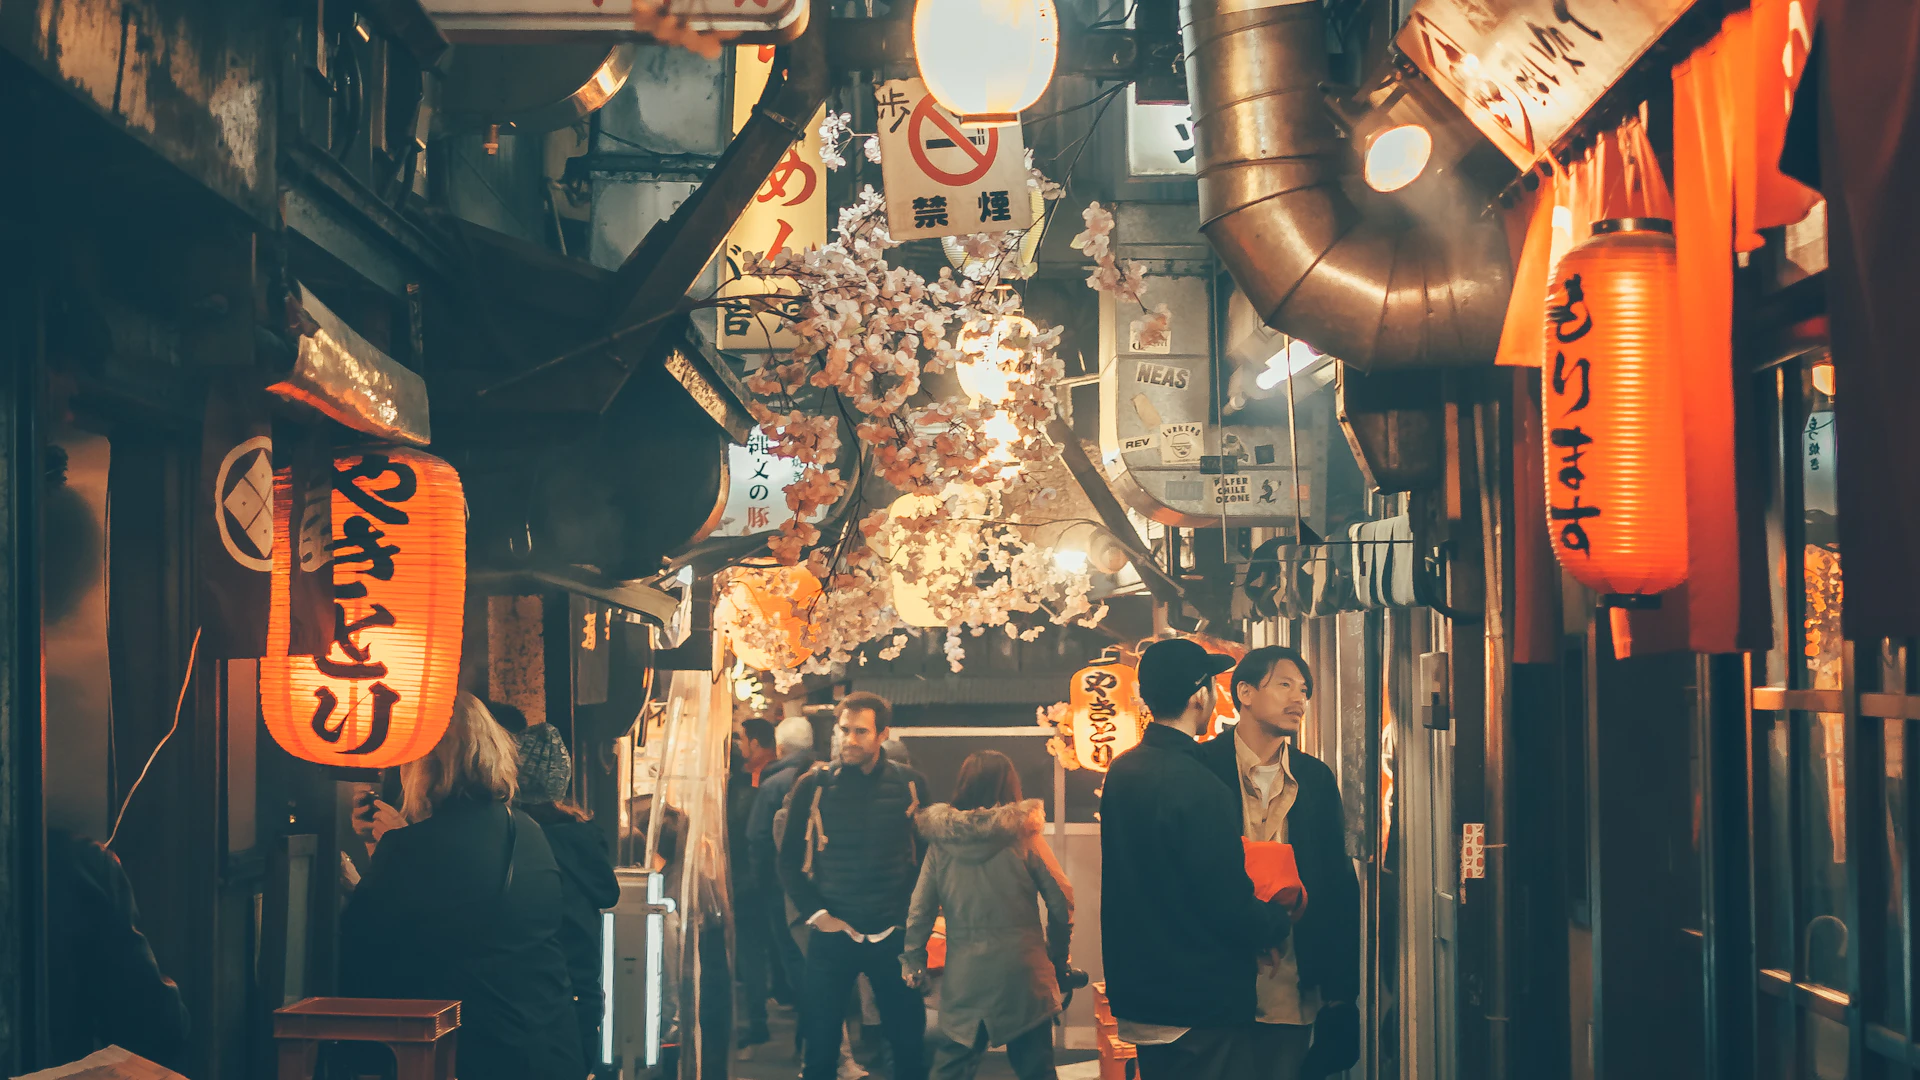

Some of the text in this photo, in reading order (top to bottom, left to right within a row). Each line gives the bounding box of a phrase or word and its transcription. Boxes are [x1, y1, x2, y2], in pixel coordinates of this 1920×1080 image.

[912, 190, 1012, 229] 禁煙
[1137, 363, 1188, 389] NEAS
[1125, 437, 1150, 449] REV
[1213, 477, 1248, 487] PLFER
[1215, 494, 1250, 503] OZONE
[311, 455, 417, 755] やきとり
[1085, 671, 1117, 768] やきとり
